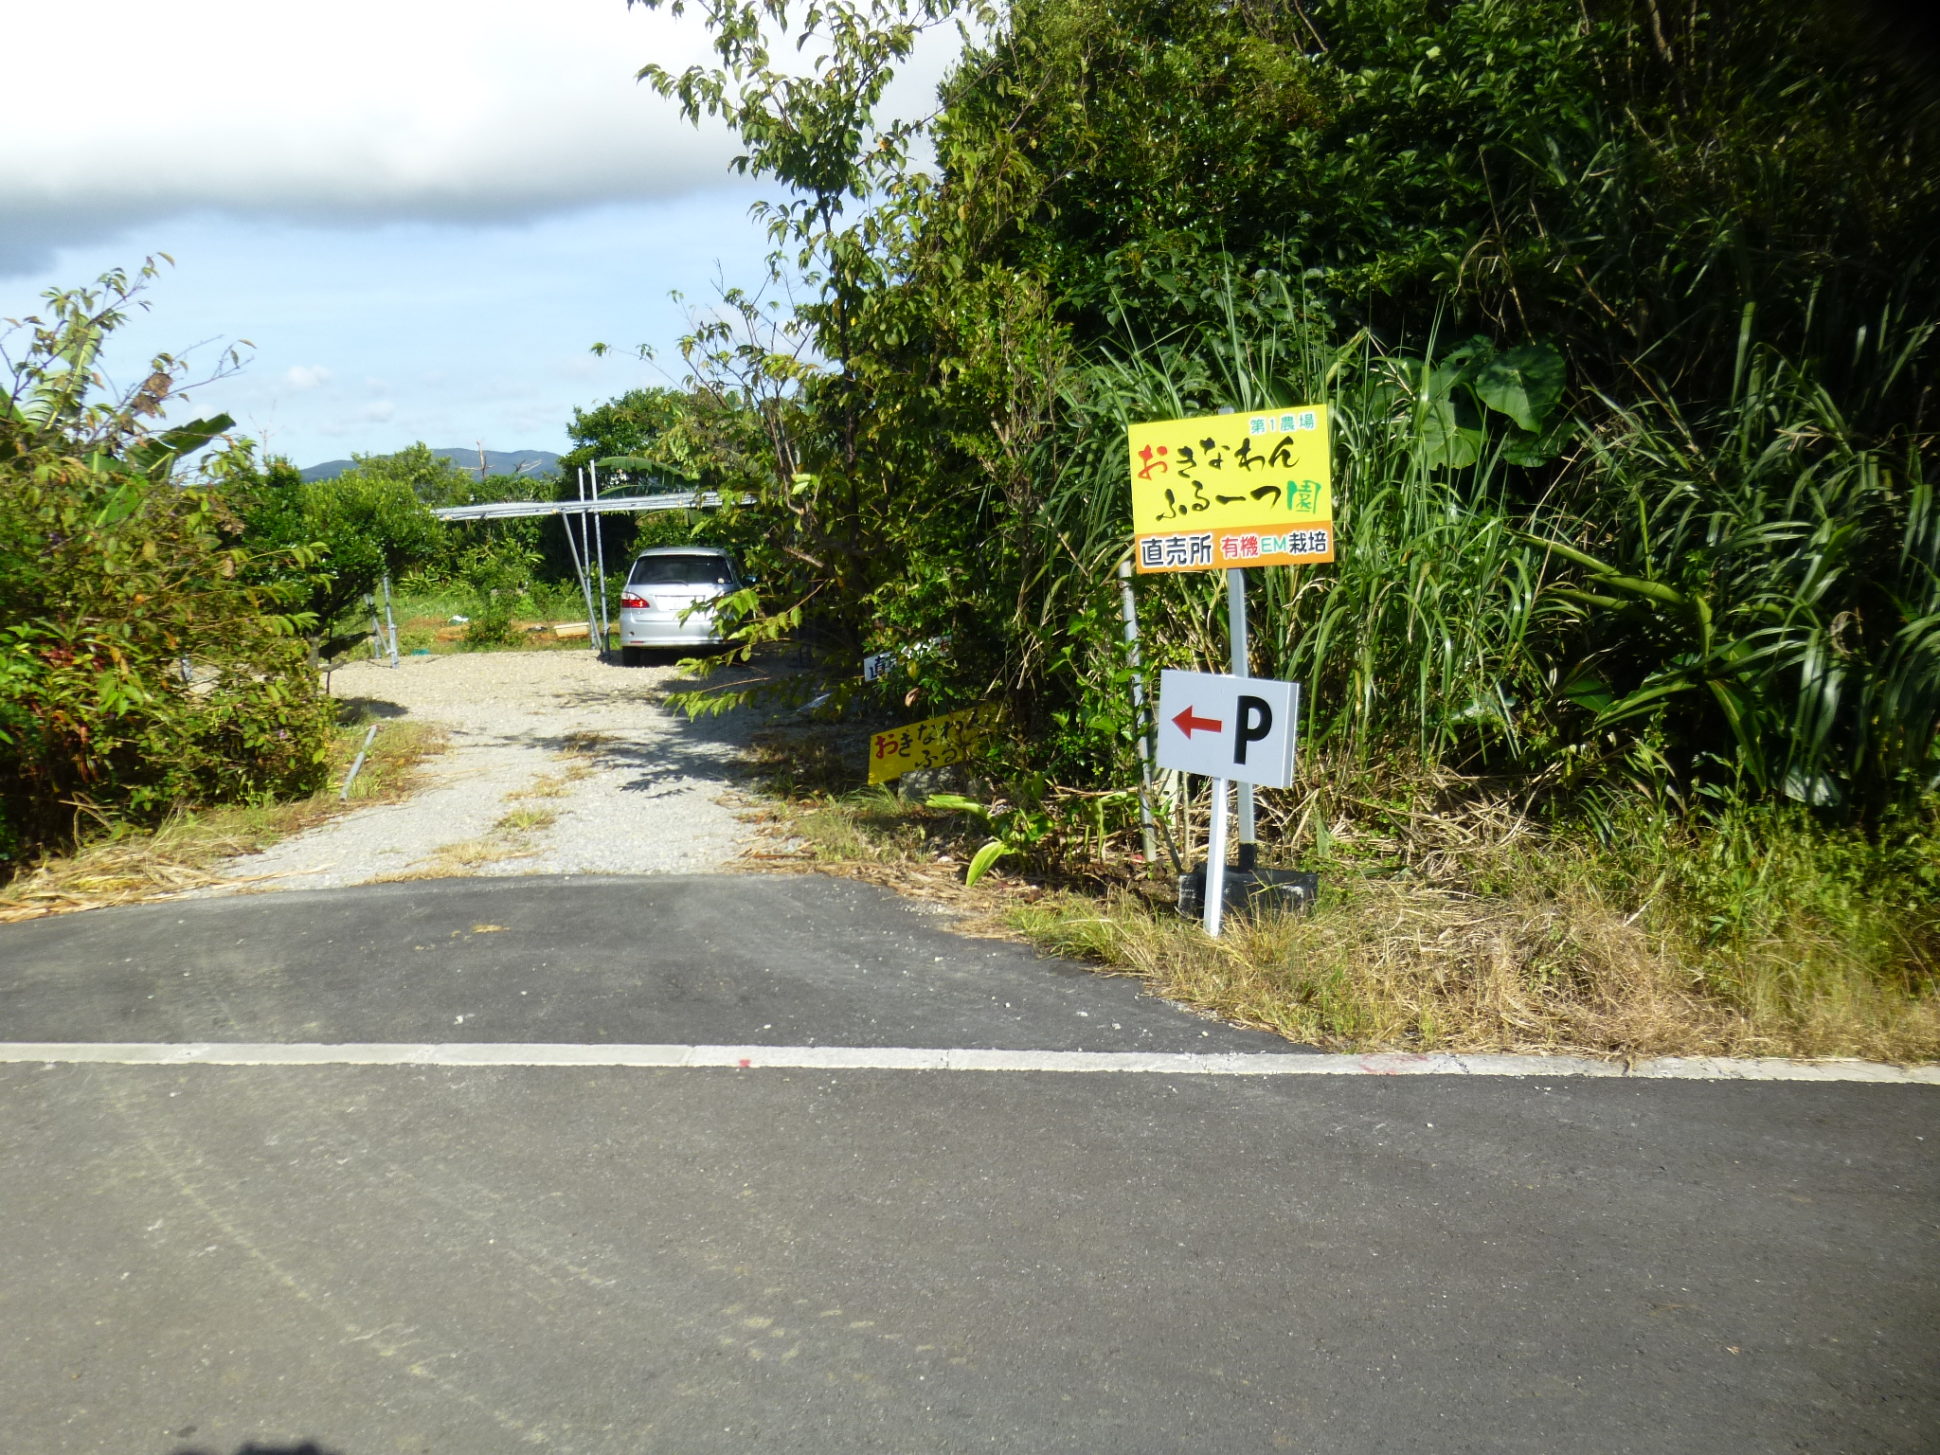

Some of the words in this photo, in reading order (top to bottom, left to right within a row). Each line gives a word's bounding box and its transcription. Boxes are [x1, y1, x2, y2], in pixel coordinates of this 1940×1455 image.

[1250, 414, 1314, 434] 第1農場
[1138, 436, 1300, 481] おきなわん
[1156, 480, 1321, 521] ふるーつ園
[1142, 534, 1212, 567] 直売所
[1221, 530, 1327, 558] 有機EM栽培
[1233, 695, 1273, 765] P
